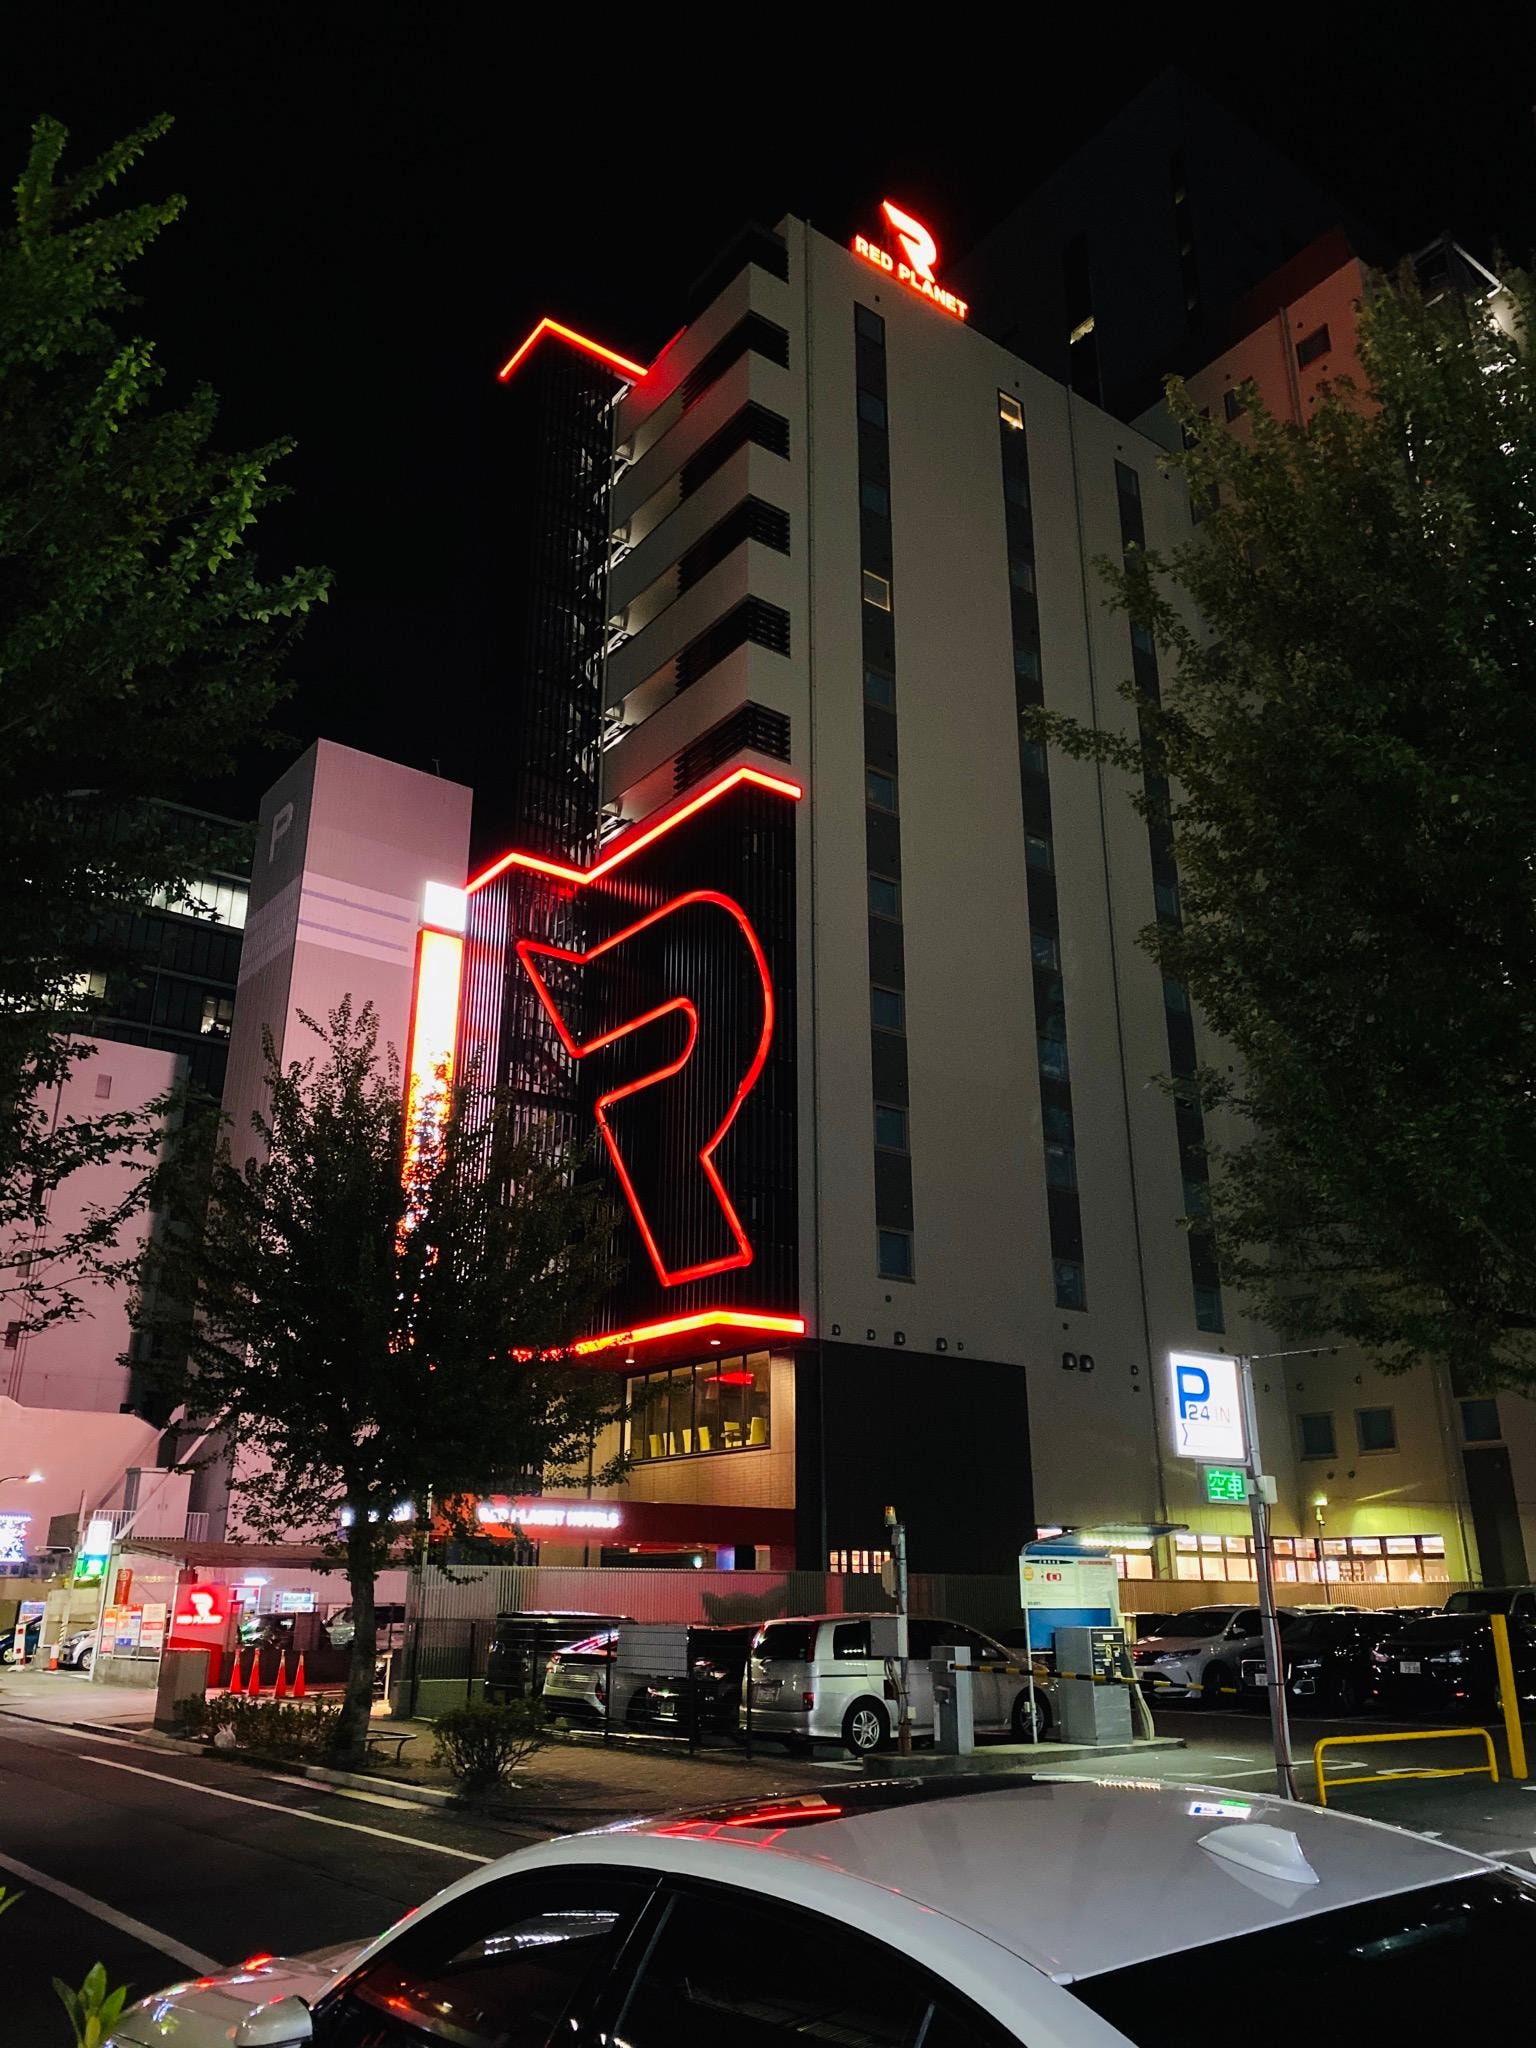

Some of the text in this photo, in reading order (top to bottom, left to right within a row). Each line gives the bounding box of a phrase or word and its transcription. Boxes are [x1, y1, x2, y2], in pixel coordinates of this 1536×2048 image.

[855, 234, 968, 318] RED PLANET
[269, 802, 294, 863] P
[1176, 1365, 1210, 1419] P
[1188, 1404, 1210, 1421] 24
[1208, 1470, 1246, 1501] 空車
